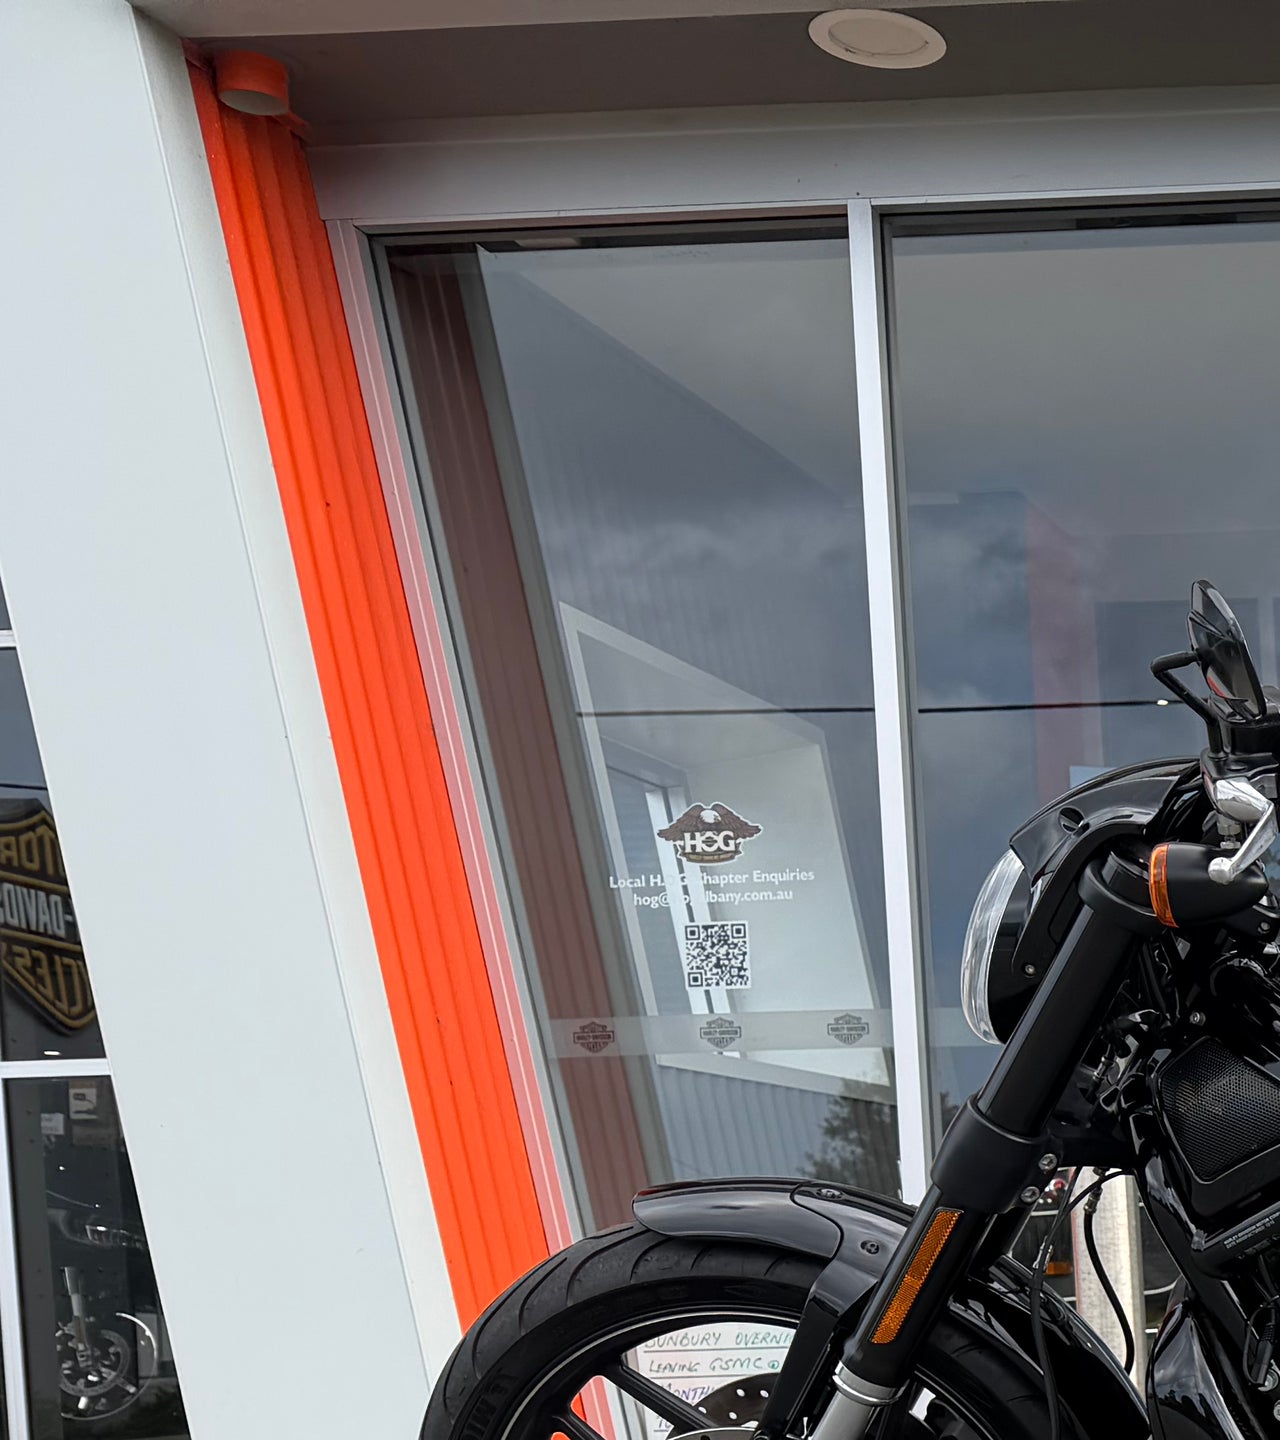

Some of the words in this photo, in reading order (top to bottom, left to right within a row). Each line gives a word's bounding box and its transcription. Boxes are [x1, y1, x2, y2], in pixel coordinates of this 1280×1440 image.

[684, 830, 736, 853] HOG
[609, 873, 646, 889] Local
[698, 871, 749, 891] hapter
[752, 868, 815, 885] Enquiries
